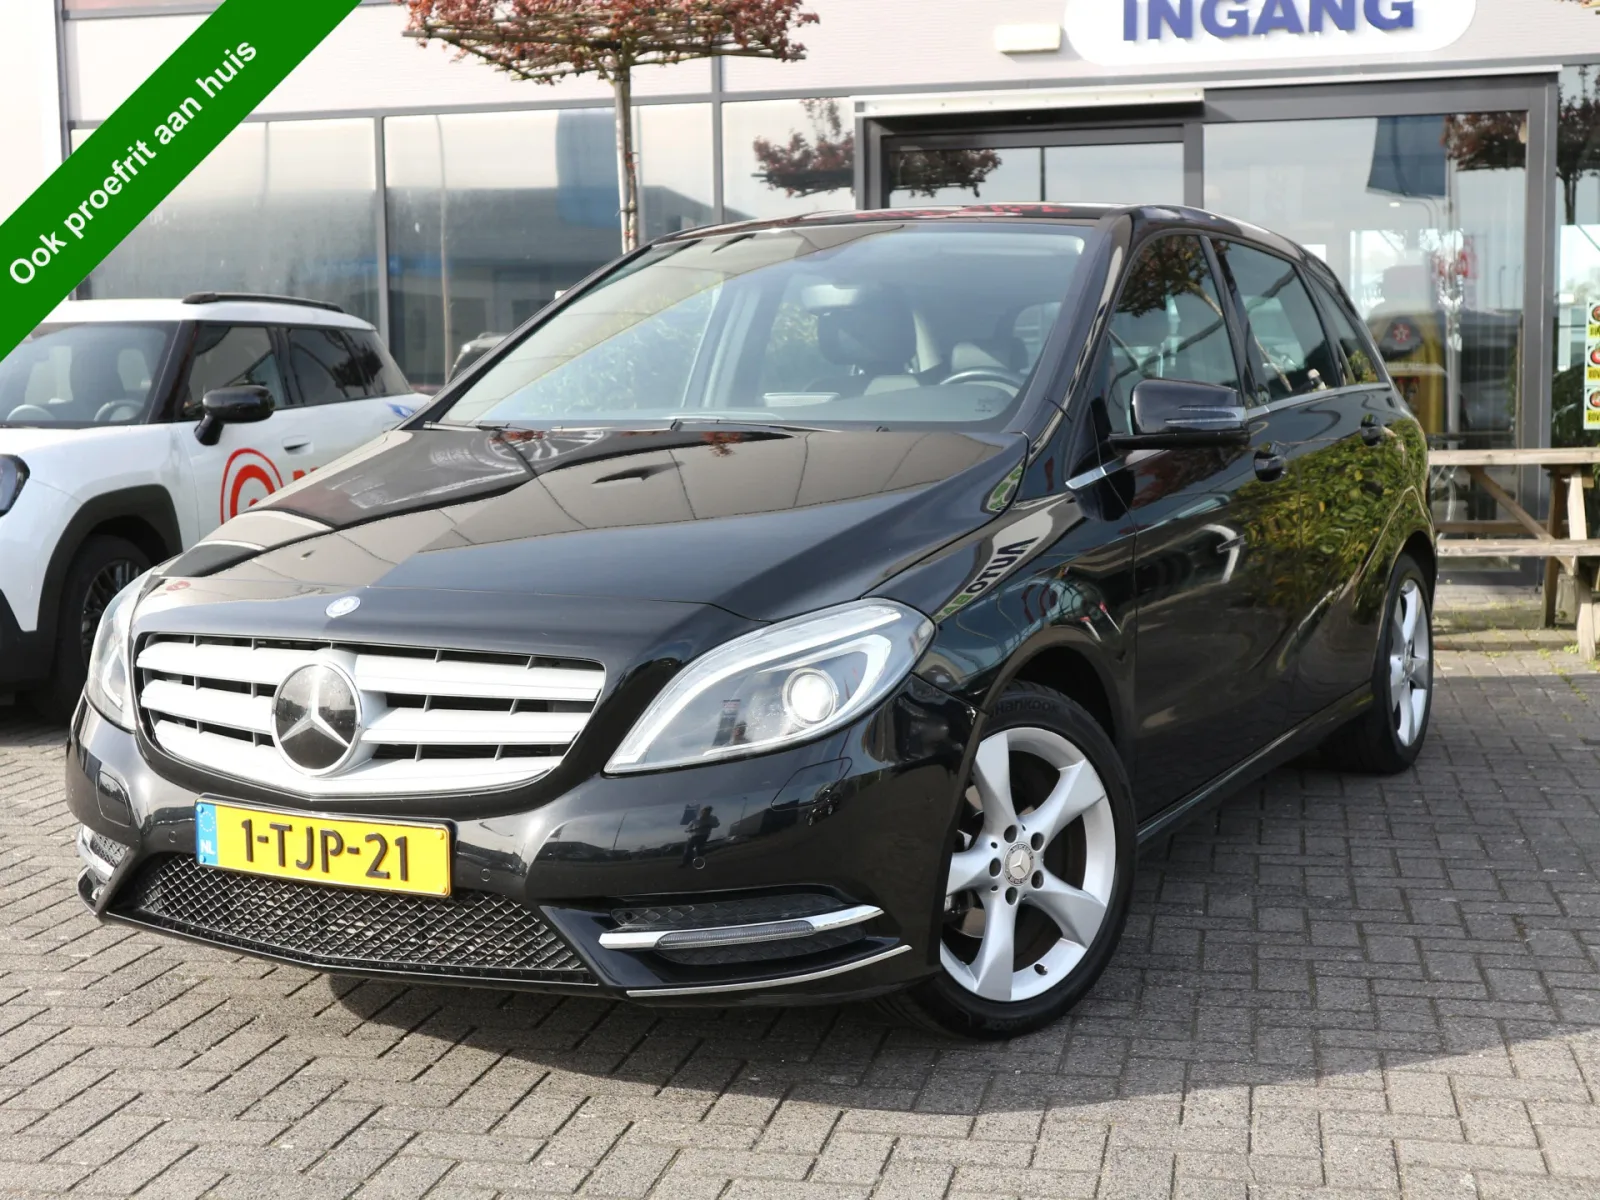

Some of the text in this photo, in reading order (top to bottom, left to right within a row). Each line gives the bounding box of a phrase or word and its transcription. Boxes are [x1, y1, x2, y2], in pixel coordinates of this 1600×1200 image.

[1123, 0, 1414, 41] INGANG
[200, 839, 216, 855] NL
[241, 818, 409, 882] 1-TJP-21
